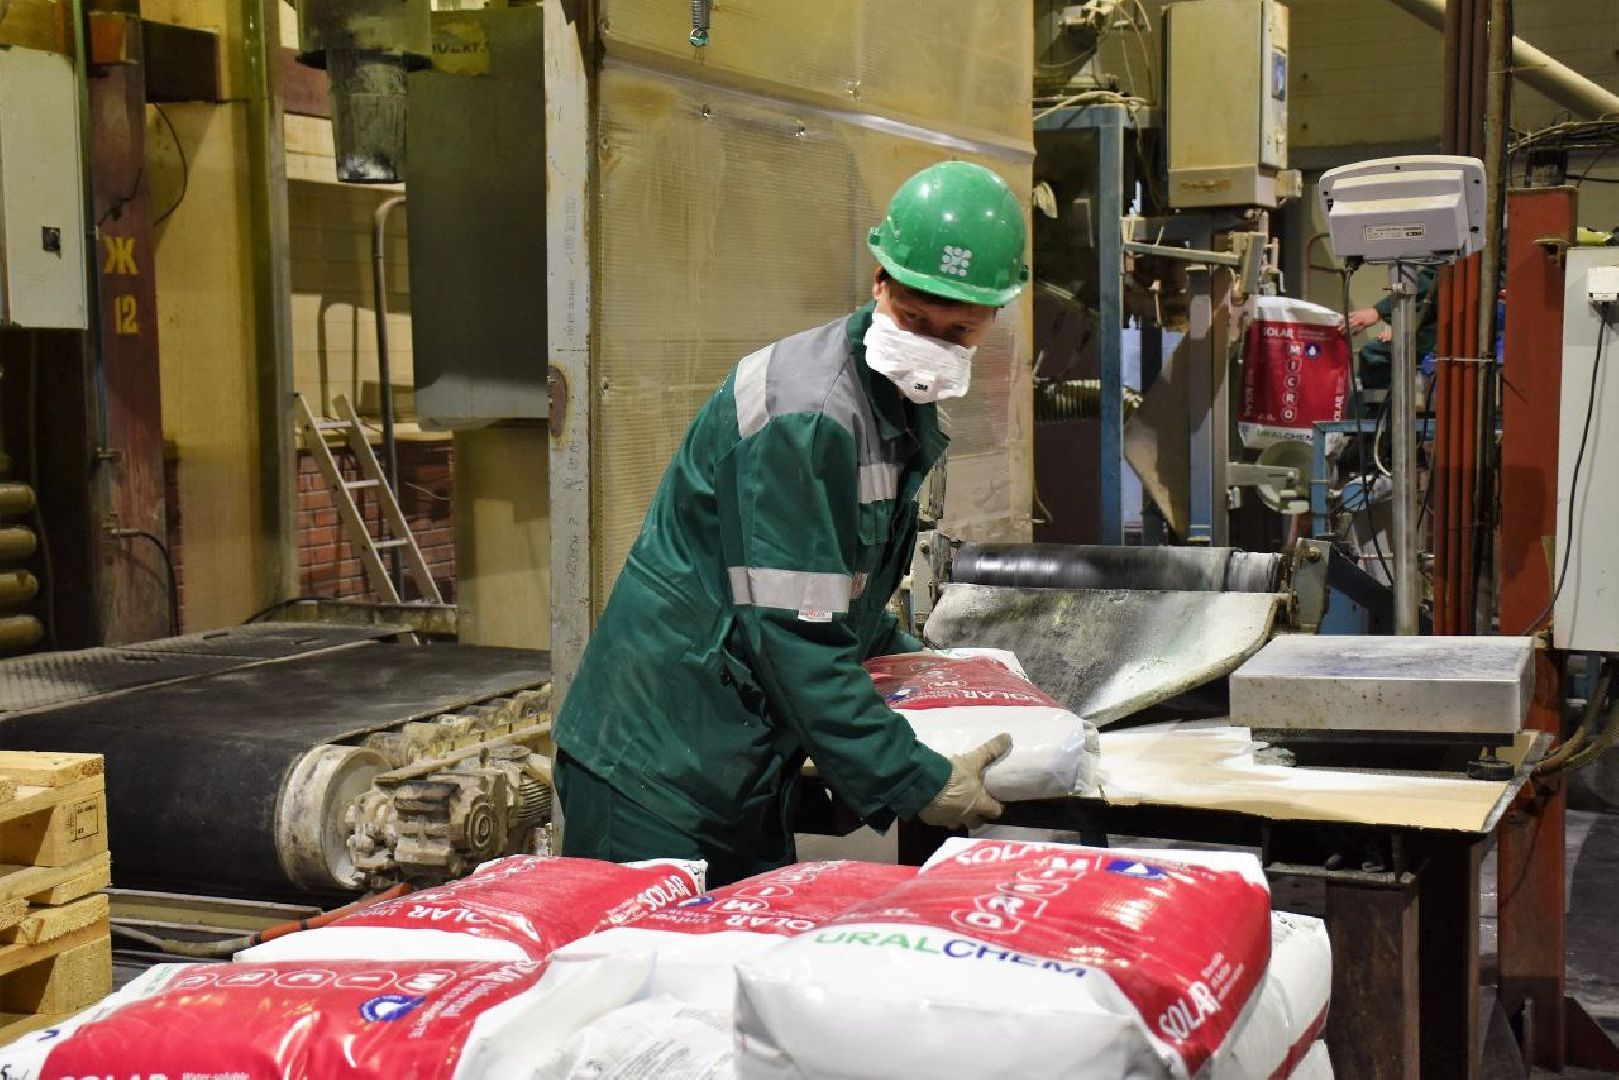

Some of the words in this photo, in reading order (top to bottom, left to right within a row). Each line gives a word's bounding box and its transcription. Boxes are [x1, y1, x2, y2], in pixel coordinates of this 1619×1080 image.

[103, 236, 139, 274] Ж
[115, 295, 139, 335] 12
[814, 932, 1087, 977] URALCHEM
[1159, 981, 1221, 1044] SOLAR
